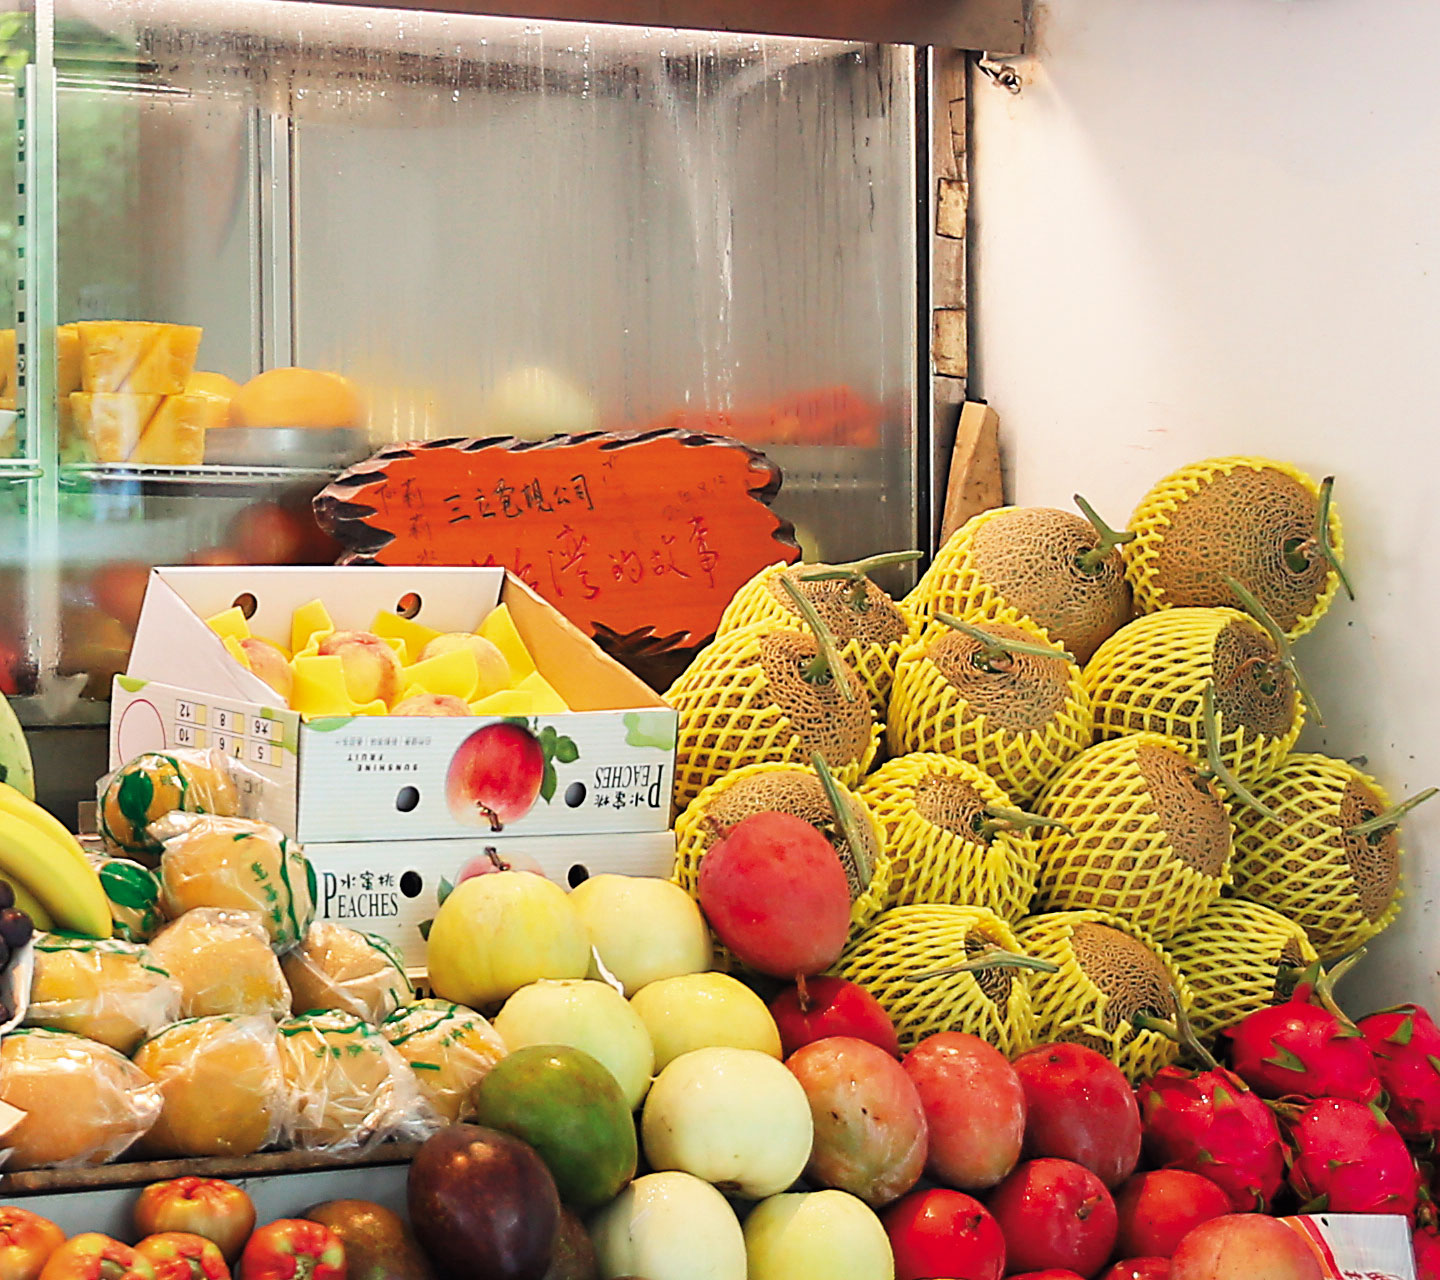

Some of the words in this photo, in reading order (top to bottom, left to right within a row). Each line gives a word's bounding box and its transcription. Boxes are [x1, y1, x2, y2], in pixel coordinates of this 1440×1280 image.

[593, 764, 664, 808] PEACHES
[323, 872, 399, 919] PEACHES
[341, 871, 395, 891] 水蜜桃
